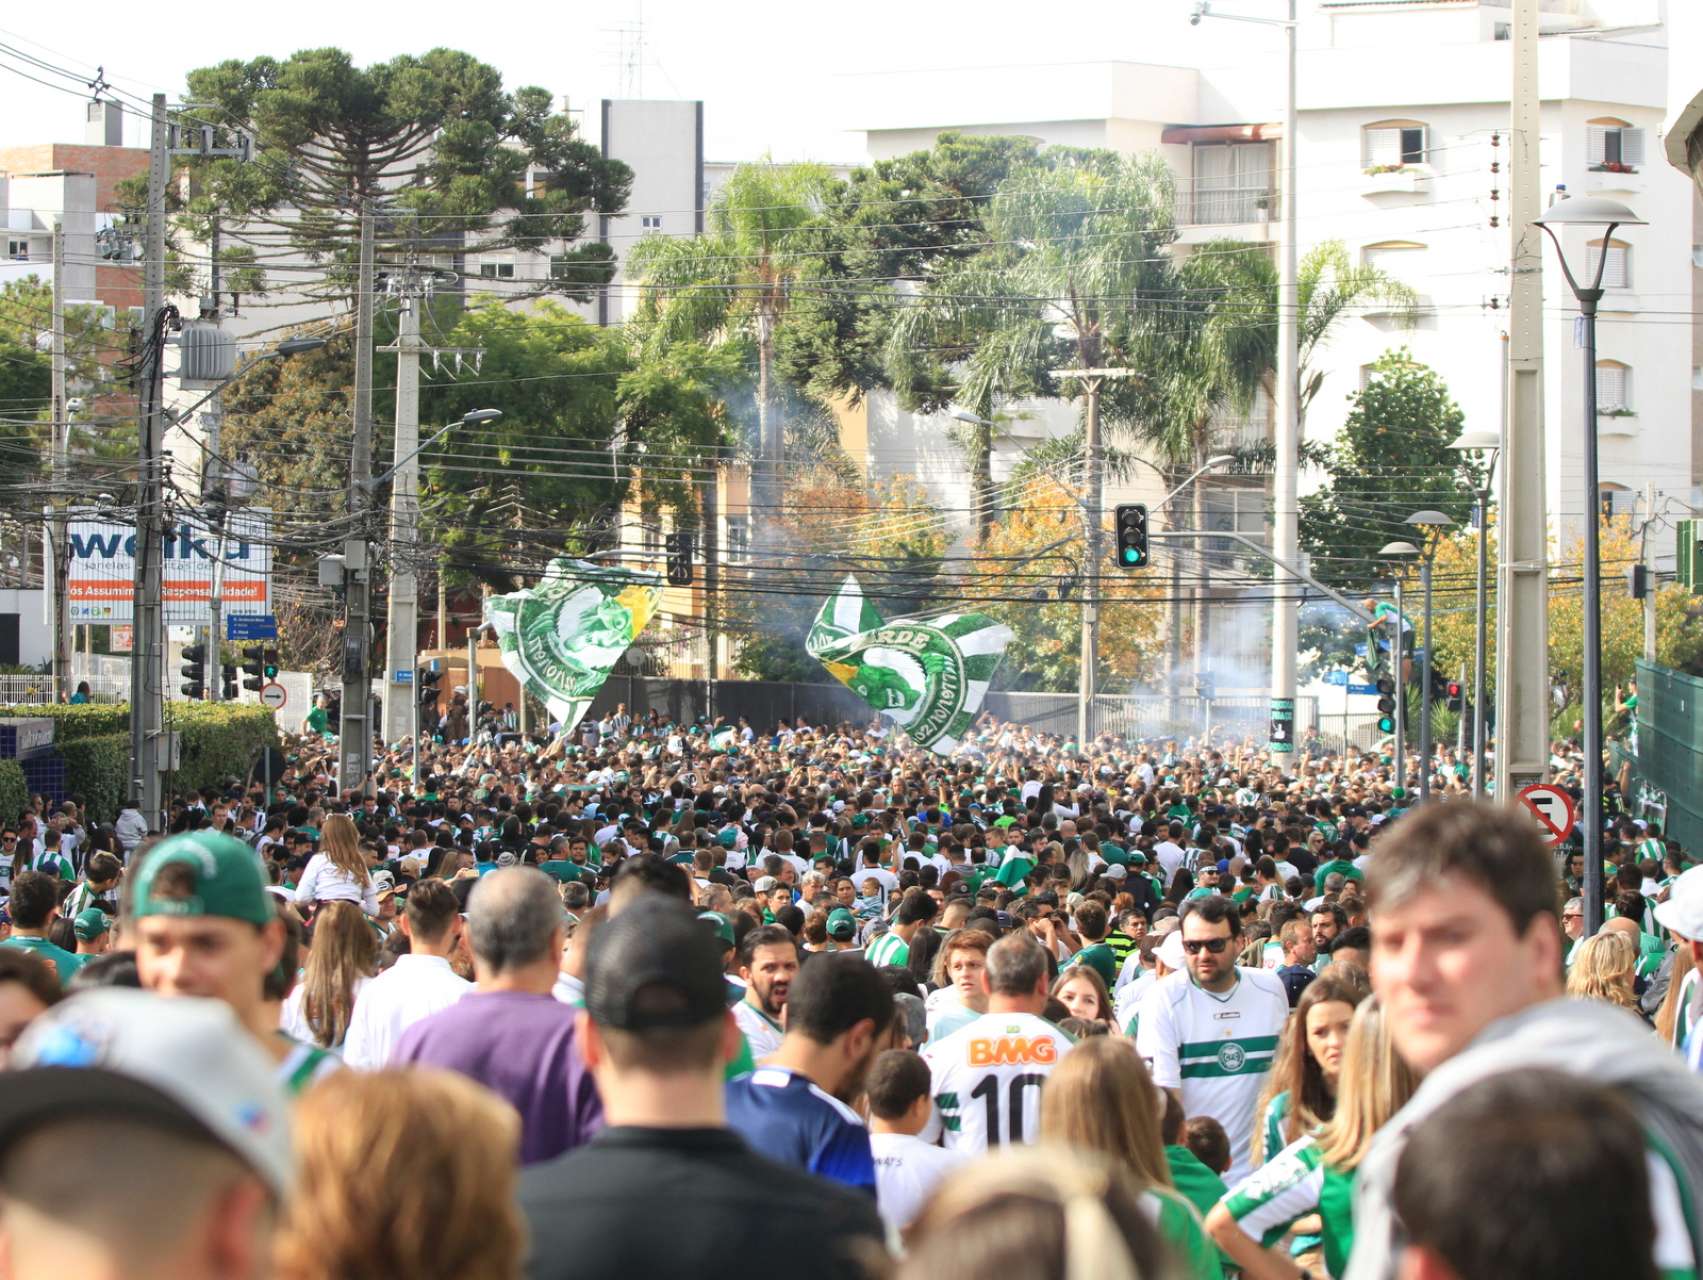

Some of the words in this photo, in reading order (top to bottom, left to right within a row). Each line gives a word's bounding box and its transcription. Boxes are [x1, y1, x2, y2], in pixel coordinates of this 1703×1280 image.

[85, 585, 134, 596] Assumim
[162, 586, 258, 598] Responsalidade!
[969, 1036, 1057, 1066] BMG
[971, 1074, 1046, 1150] 10
